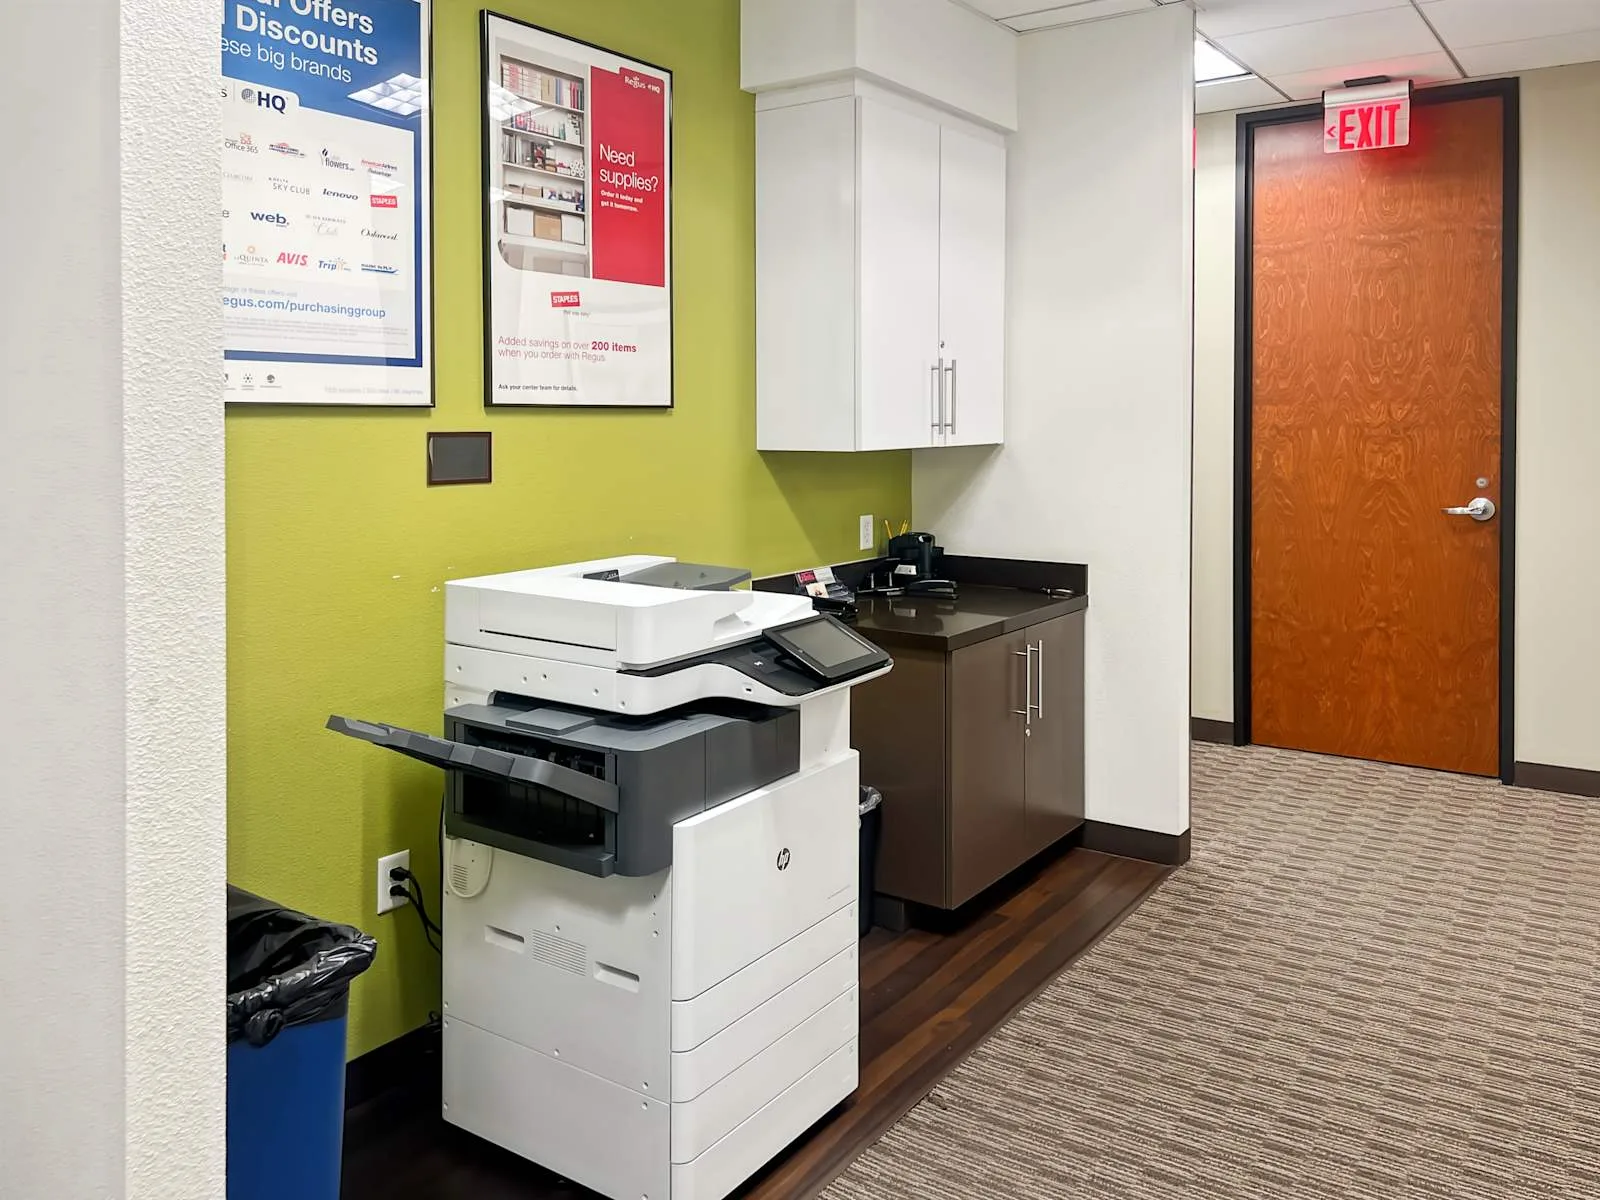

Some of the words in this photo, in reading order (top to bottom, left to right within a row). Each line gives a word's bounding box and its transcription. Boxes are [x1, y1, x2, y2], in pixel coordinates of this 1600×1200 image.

[290, 0, 374, 35] Offers
[236, 4, 378, 66] Discounts
[257, 43, 286, 70] big
[290, 51, 352, 83] brands
[257, 91, 286, 114] HQ
[1339, 104, 1401, 149] EXIT
[224, 141, 245, 152] Office
[599, 144, 635, 167] Need
[272, 182, 288, 192] SKY
[289, 185, 310, 195] CLUB
[599, 168, 659, 192] supplies?
[322, 188, 359, 201] lenovo
[276, 252, 308, 266] AVIS
[552, 295, 579, 303] STAPLES
[498, 336, 527, 346] Added
[529, 339, 559, 350] savings
[573, 342, 590, 350] over
[591, 341, 610, 351] 200
[612, 342, 637, 353] items
[498, 349, 522, 358] when
[524, 351, 539, 360] you
[540, 351, 562, 360] order
[563, 351, 580, 360] with
[581, 352, 607, 364] Regus
